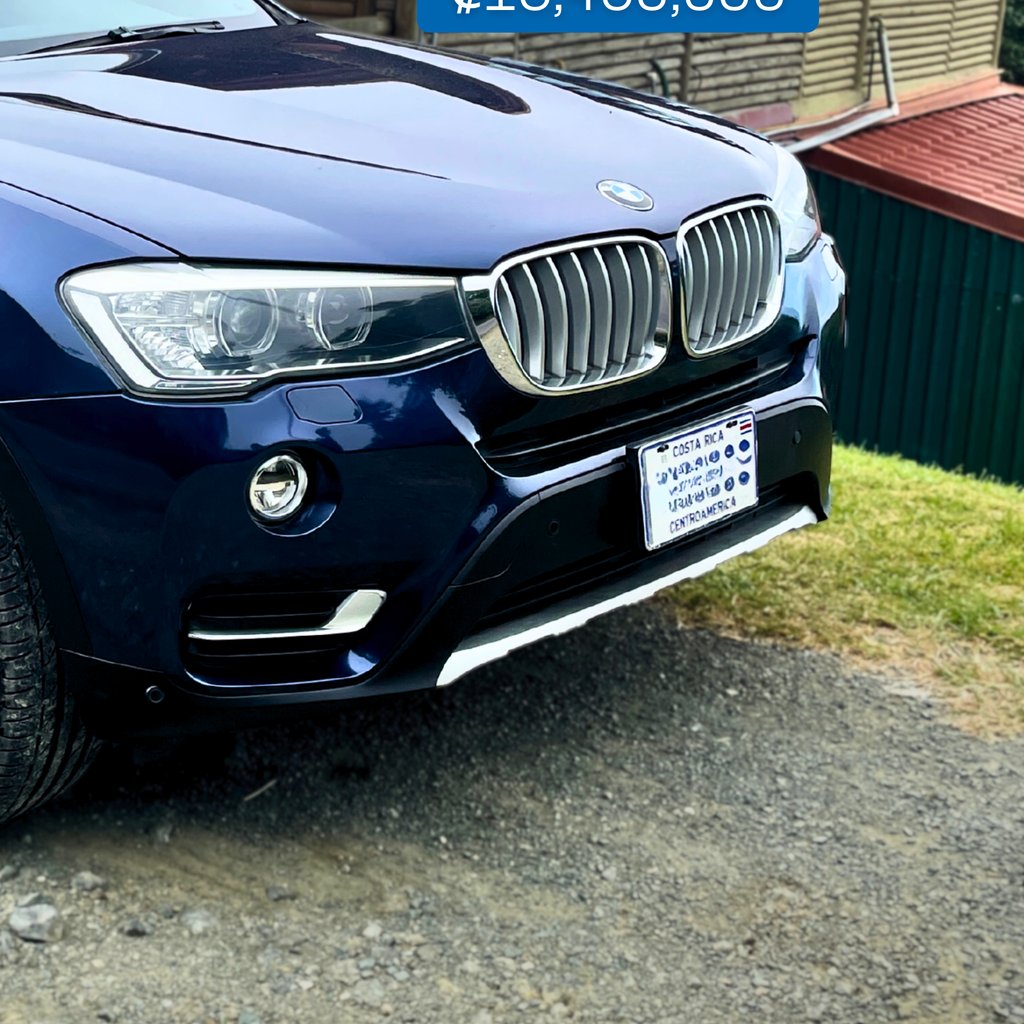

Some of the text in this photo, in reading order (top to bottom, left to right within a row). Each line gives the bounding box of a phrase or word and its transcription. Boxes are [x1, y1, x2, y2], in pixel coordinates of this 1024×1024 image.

[673, 429, 724, 458] COSTA RICA
[669, 496, 737, 534] CENTROAMERICA
